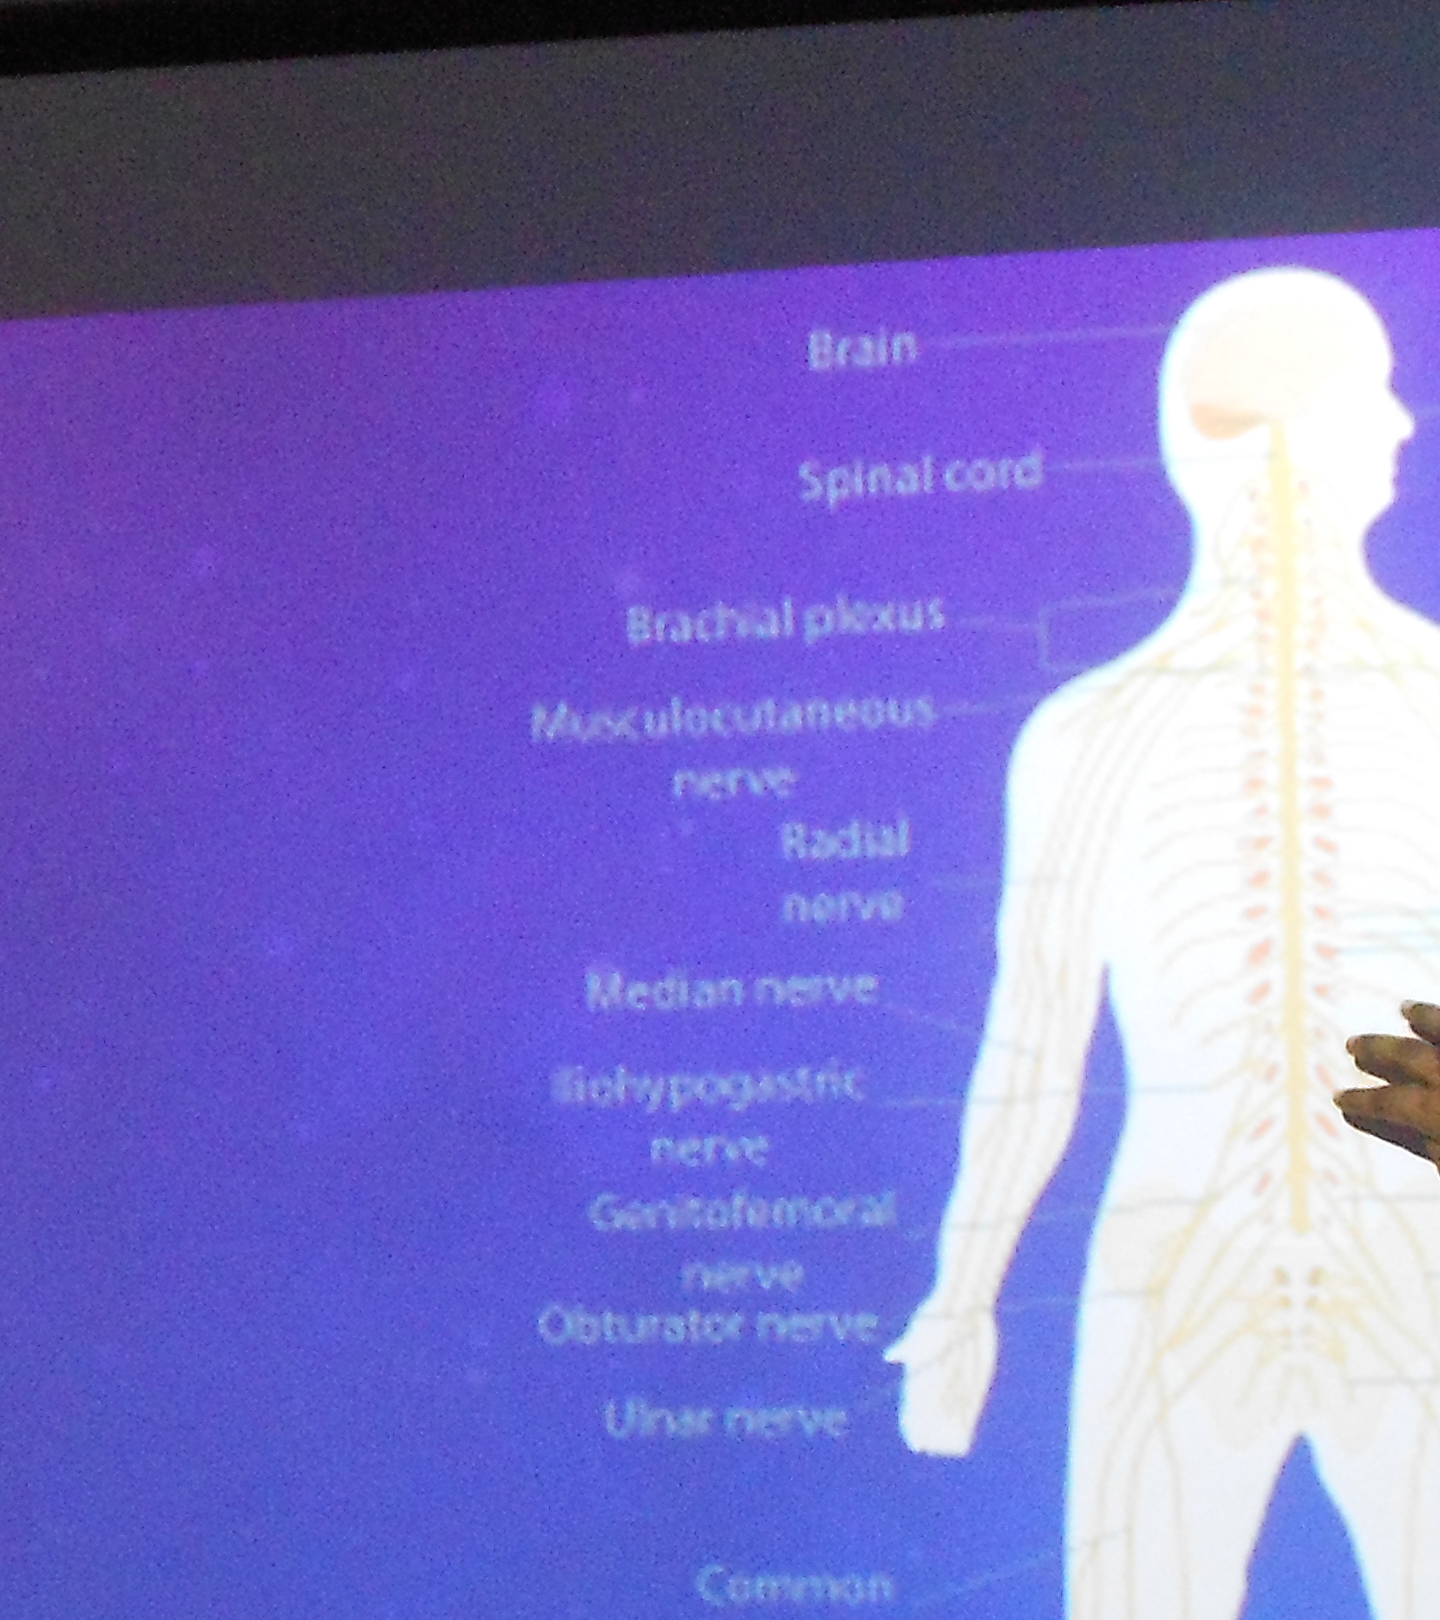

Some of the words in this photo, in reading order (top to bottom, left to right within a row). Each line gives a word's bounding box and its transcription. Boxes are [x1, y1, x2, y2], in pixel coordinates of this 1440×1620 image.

[809, 330, 918, 371] Brain
[799, 455, 934, 509] Spinal
[943, 447, 1044, 492] cord
[627, 597, 794, 645] Brachial
[804, 597, 946, 643] plexus
[533, 693, 940, 741] Musculocutaneous
[674, 766, 797, 800] nerve
[782, 817, 910, 859] Radial
[784, 891, 904, 922] nerve
[587, 968, 744, 1010] Median
[756, 974, 879, 1006] nerve
[651, 1136, 769, 1166] nerve
[684, 1261, 804, 1292] nerve
[538, 1304, 745, 1345] Obturator
[758, 1312, 879, 1342] nerve
[605, 1398, 714, 1437] Ulnar
[727, 1406, 847, 1437] nerve
[697, 1565, 895, 1606] Common
